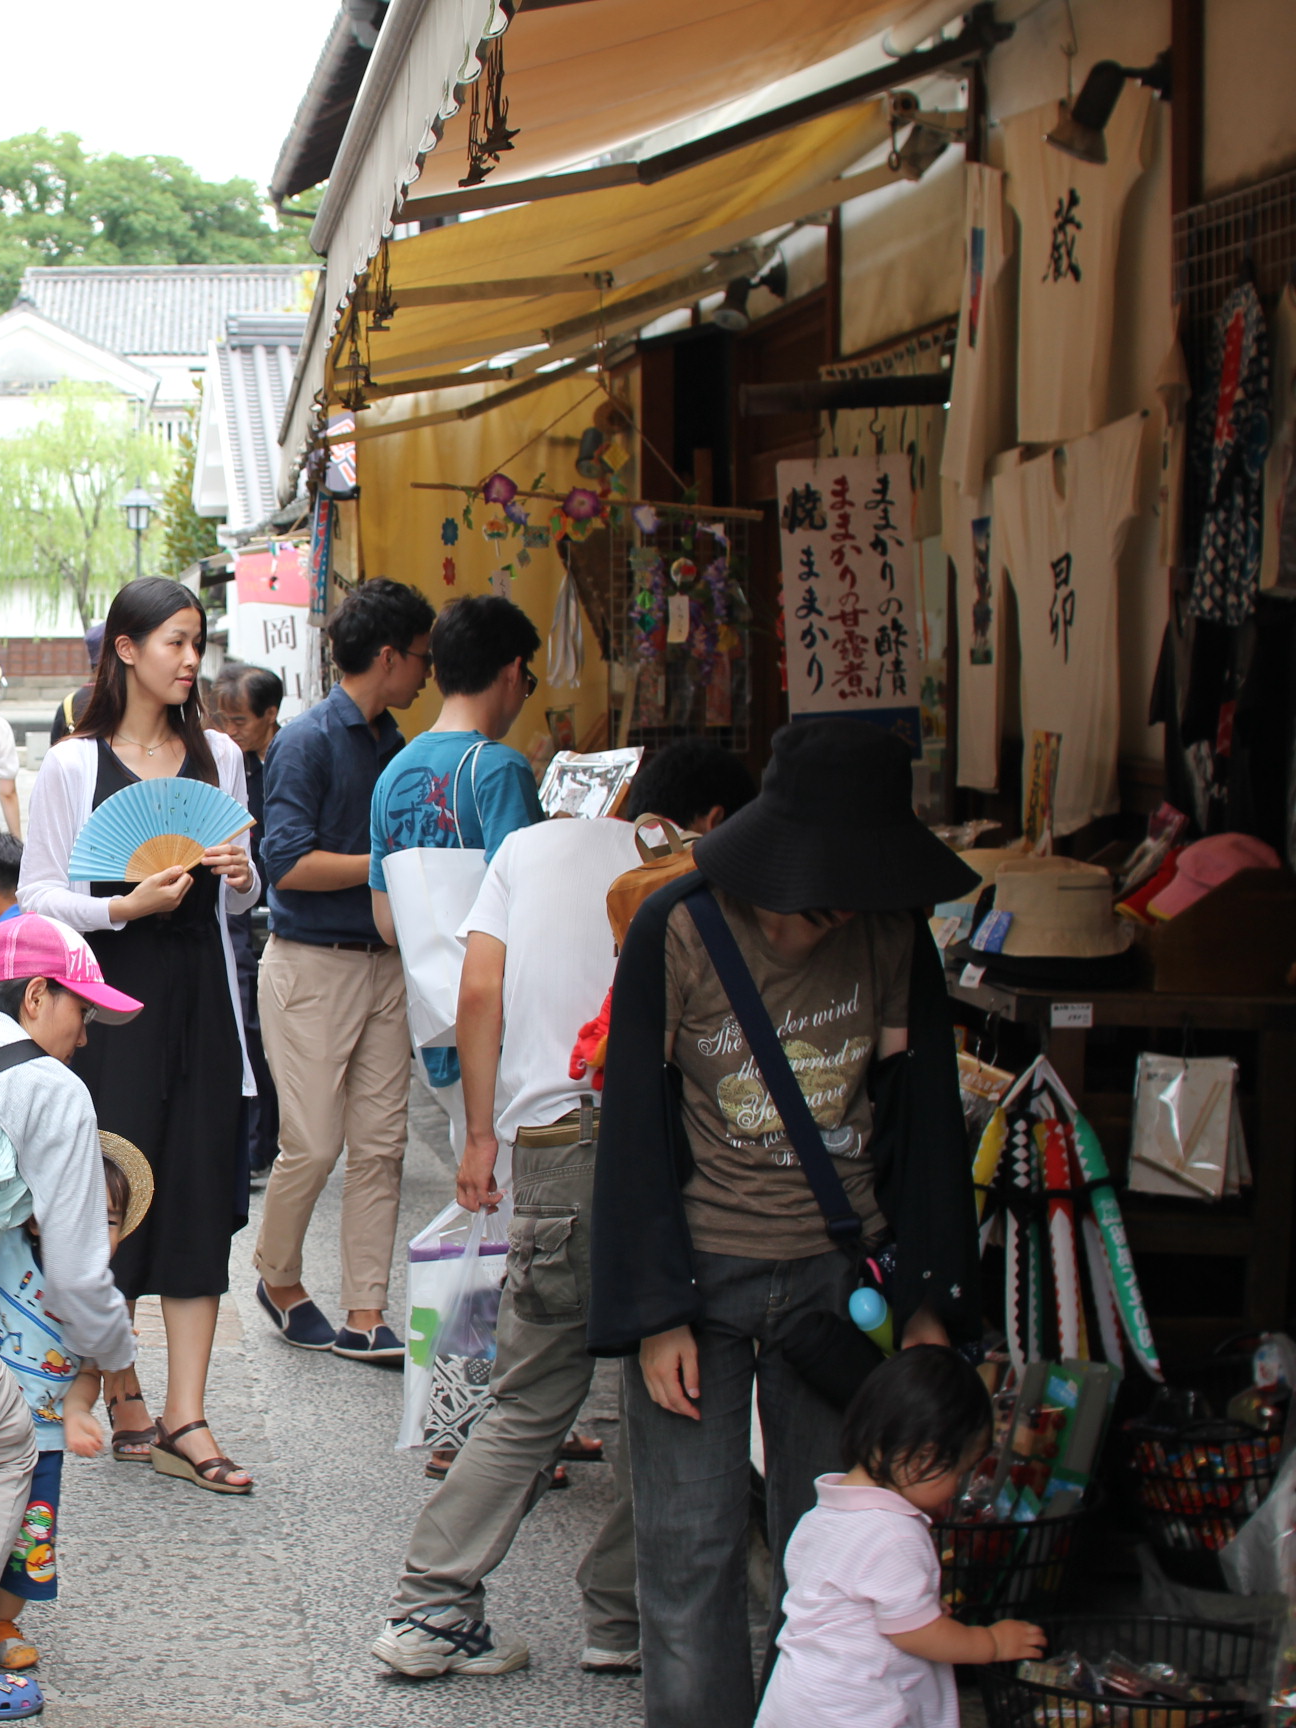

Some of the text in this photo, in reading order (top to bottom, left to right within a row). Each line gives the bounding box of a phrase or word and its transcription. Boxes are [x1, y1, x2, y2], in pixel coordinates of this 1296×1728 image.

[1042, 188, 1083, 285] 蔵
[828, 474, 873, 701] ままかりの甘露煮
[865, 473, 908, 698] ままかりの酢漬
[697, 1025, 744, 1057] The
[812, 982, 860, 1028] wind
[788, 1039, 849, 1072] arried
[737, 1092, 779, 1130] Yo
